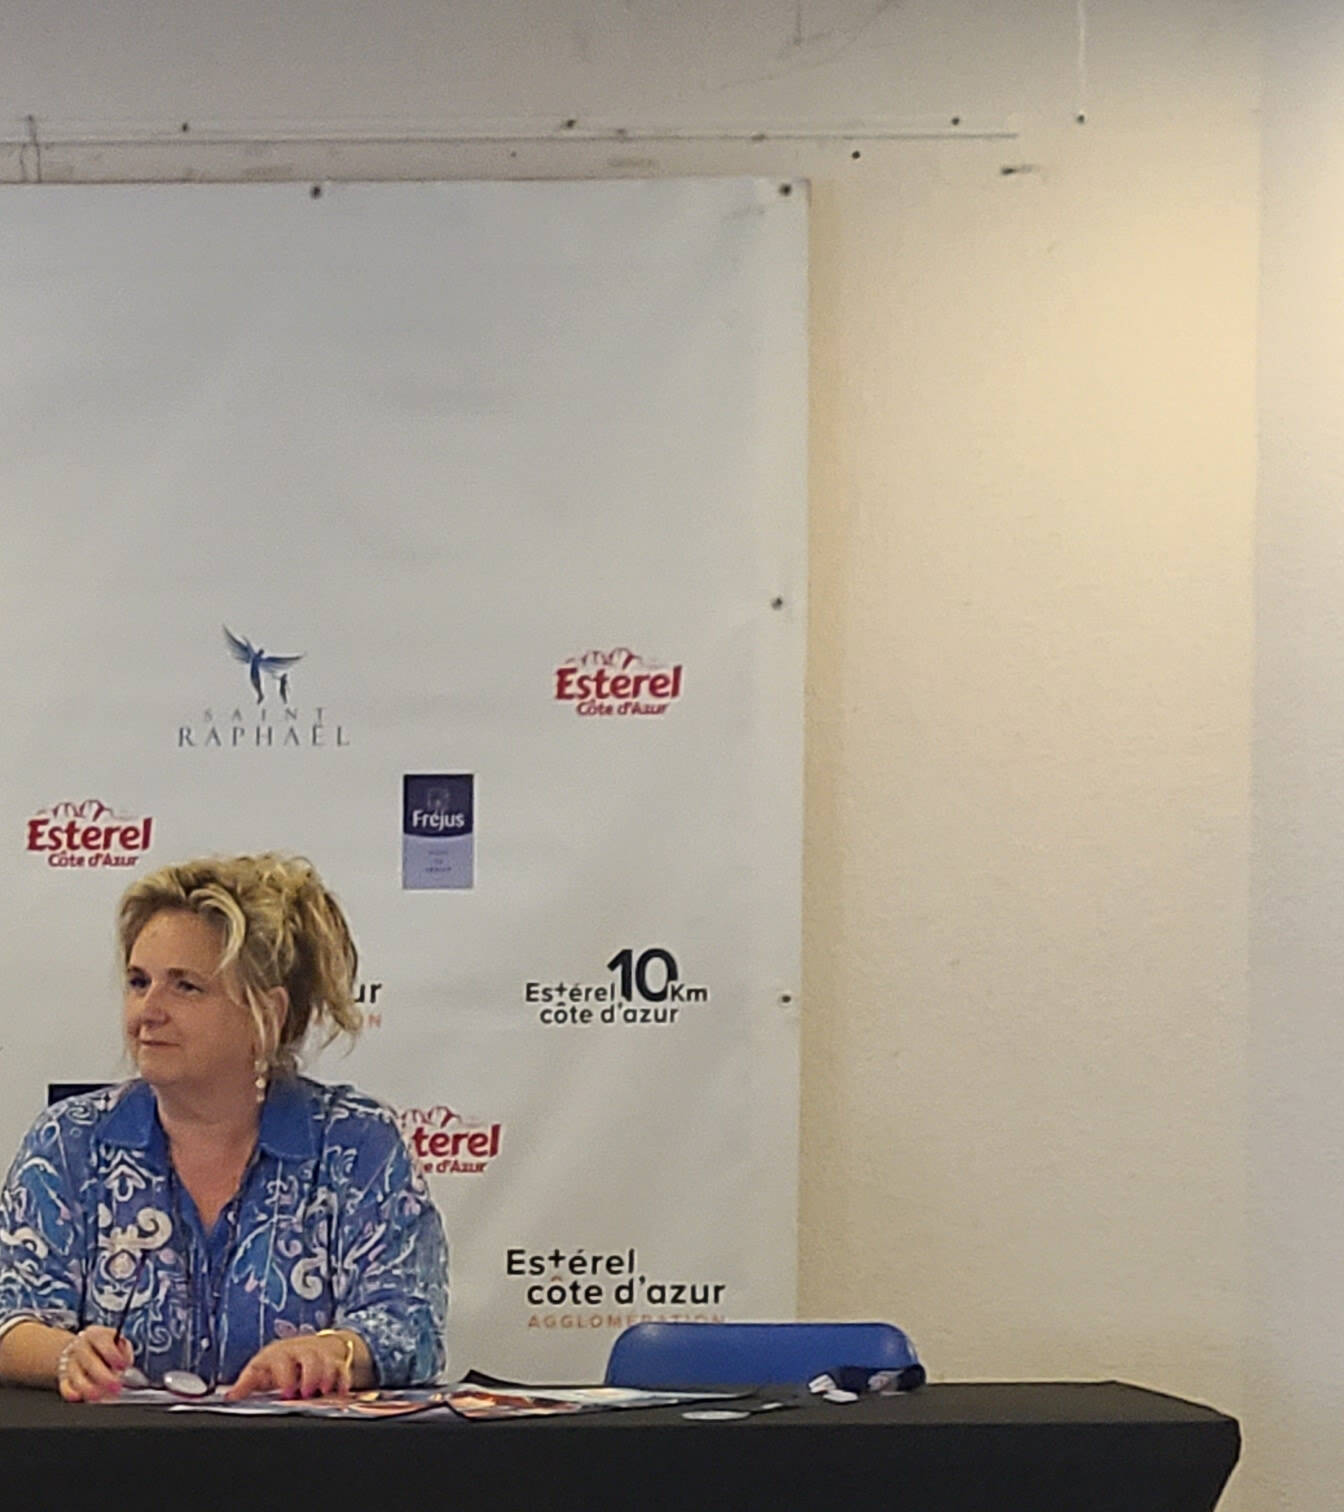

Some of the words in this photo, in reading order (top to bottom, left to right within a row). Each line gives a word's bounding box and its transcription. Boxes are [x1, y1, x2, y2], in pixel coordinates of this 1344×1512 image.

[204, 707, 326, 722] SAINT
[617, 701, 669, 715] d'Azur
[178, 723, 350, 747] RAPHAËL
[412, 809, 465, 831] Fréjus
[48, 850, 85, 867] Côte
[88, 852, 139, 867] d'Azur
[540, 1002, 593, 1024] côte
[600, 1002, 679, 1024] d'azur
[411, 1124, 501, 1157] terel
[436, 1160, 488, 1174] d'Azur
[527, 1275, 603, 1305] côte
[614, 1275, 725, 1305] d'azur
